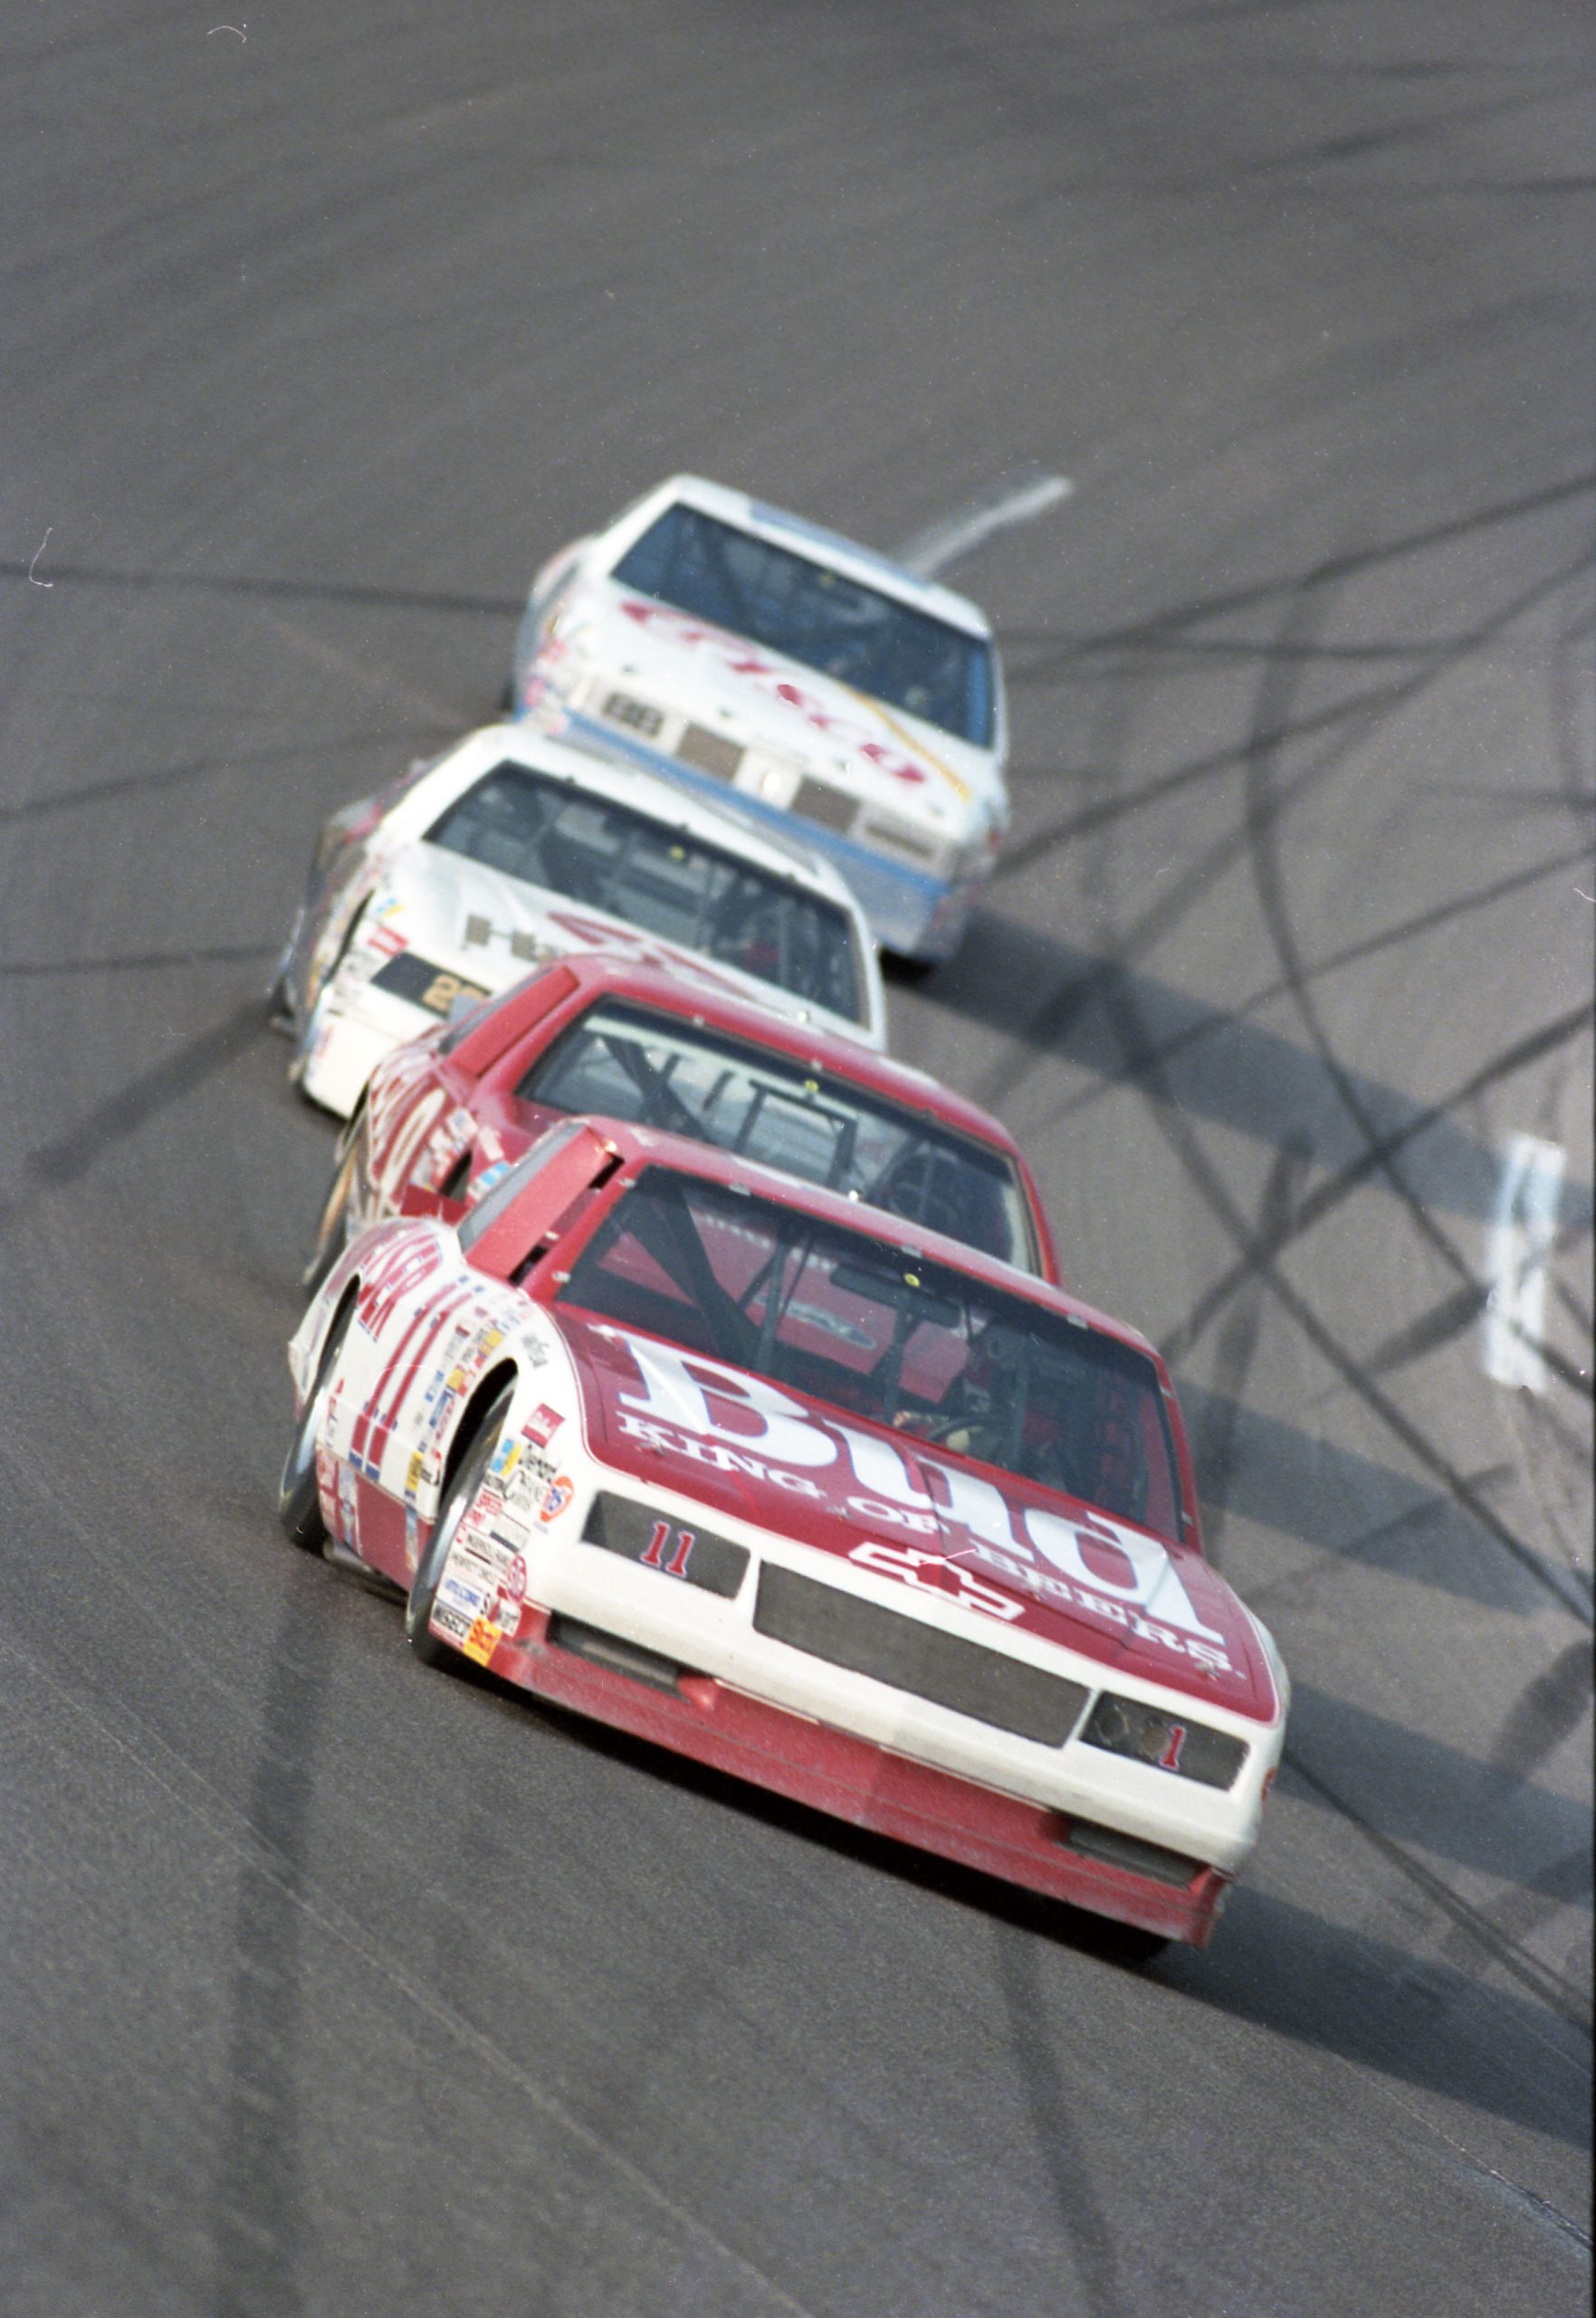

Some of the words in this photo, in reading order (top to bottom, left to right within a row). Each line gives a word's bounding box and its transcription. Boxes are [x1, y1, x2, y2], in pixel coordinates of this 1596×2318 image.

[584, 1321, 1228, 1646] Bud
[616, 1410, 829, 1500] KING
[846, 1496, 951, 1535] OF
[638, 1518, 695, 1580] 11
[1158, 1724, 1188, 1770] 1
